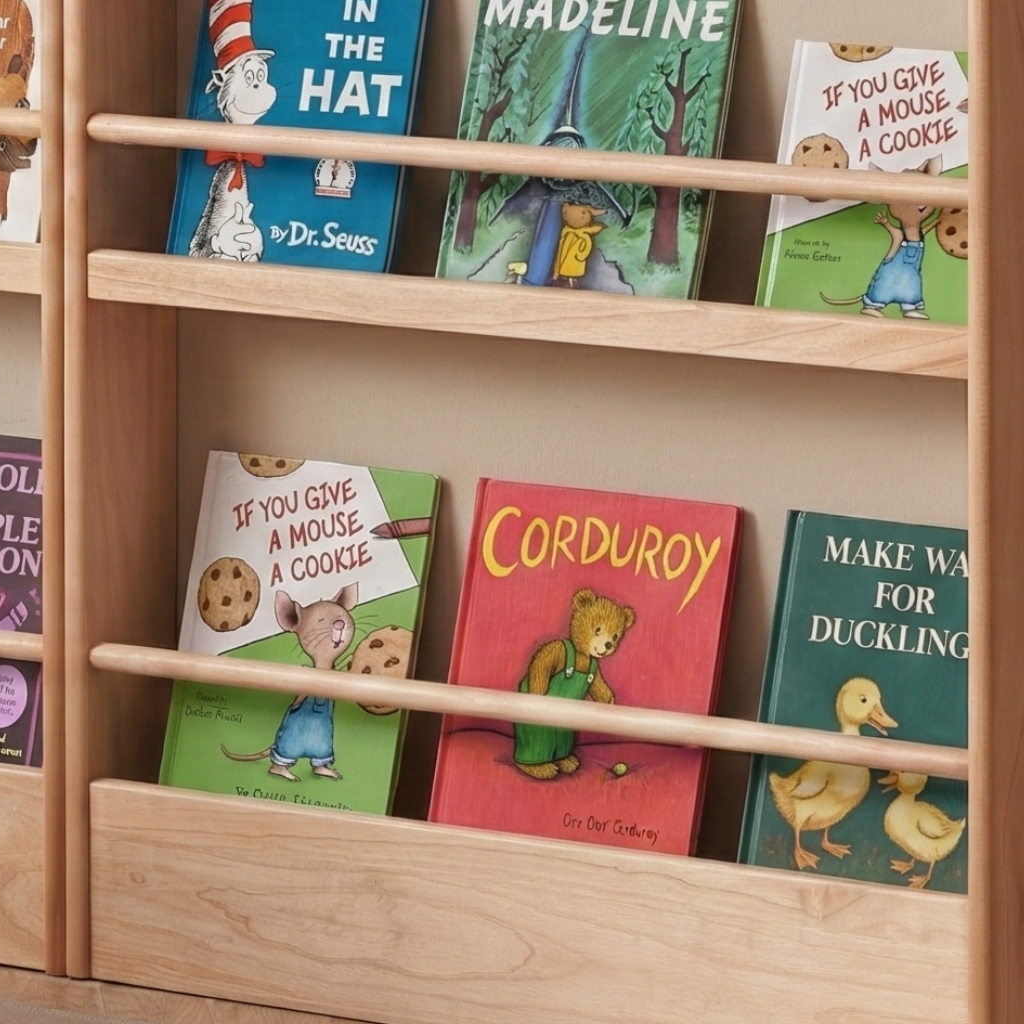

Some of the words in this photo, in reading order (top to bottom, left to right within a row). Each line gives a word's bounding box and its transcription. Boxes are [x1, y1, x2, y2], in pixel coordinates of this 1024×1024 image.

[325, 32, 385, 62] THE
[298, 68, 403, 117] HAT
[823, 81, 844, 111] IF
[848, 72, 888, 103] YOU
[893, 60, 945, 92] GIVE
[858, 108, 870, 132] A
[878, 89, 950, 126] MOUSE
[859, 138, 871, 162] A
[878, 117, 958, 154] COOKIE
[287, 220, 319, 247] Dr.
[320, 222, 379, 256] Seuss
[233, 499, 254, 531] IF
[259, 491, 298, 522] YOU
[305, 478, 357, 510] GIVE
[269, 529, 282, 554] A
[290, 510, 364, 549] MOUSE
[270, 563, 283, 587] A
[291, 541, 372, 581] COOKIE
[482, 506, 721, 616] CORDUROY
[823, 535, 915, 571] MAKE
[925, 546, 969, 578] WA
[874, 581, 935, 615] FOR
[808, 615, 969, 659] DUCKLING
